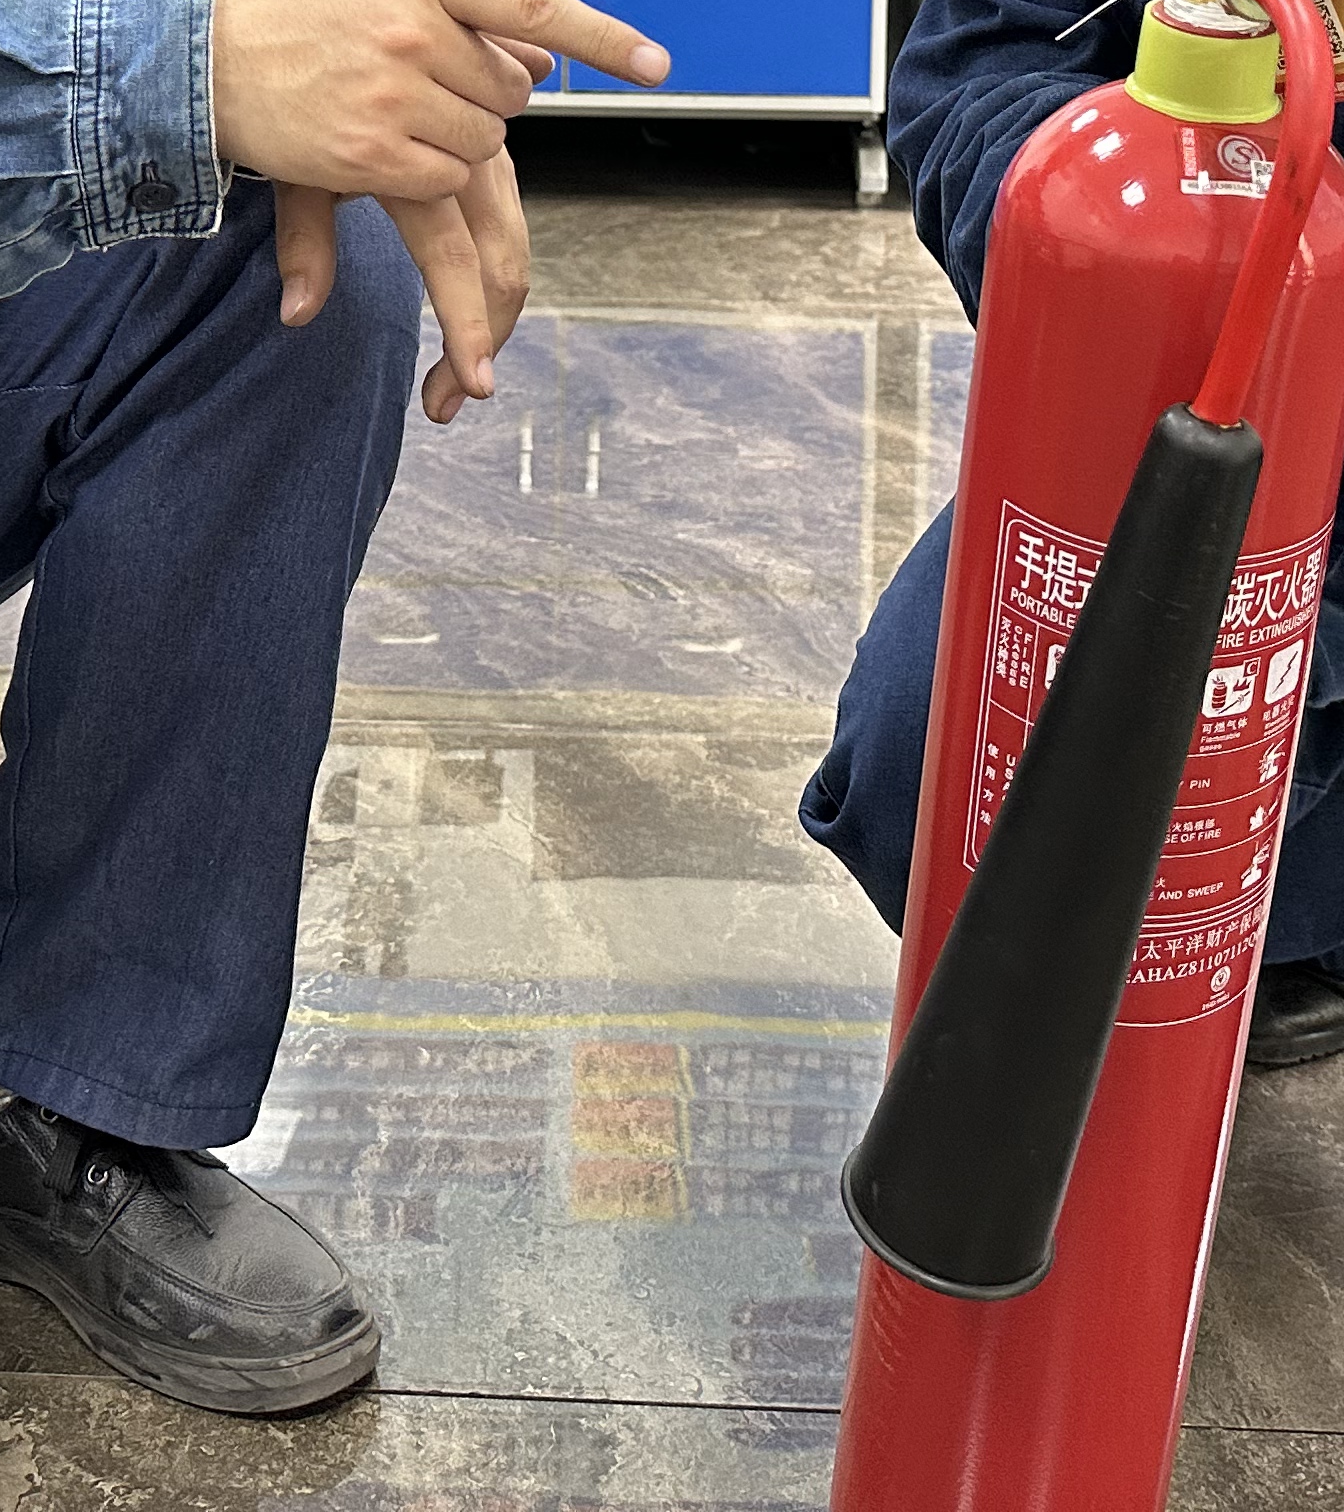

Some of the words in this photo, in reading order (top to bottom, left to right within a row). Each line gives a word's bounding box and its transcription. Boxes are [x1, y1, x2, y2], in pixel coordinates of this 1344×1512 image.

[1010, 587, 1076, 629] PORTABLE
[1019, 633, 1033, 688] FIRE
[1189, 778, 1211, 789] PIN
[1180, 832, 1195, 843] OF
[1197, 828, 1222, 841] FIRE
[1158, 890, 1183, 901] AND
[1187, 882, 1224, 898] SWEEP
